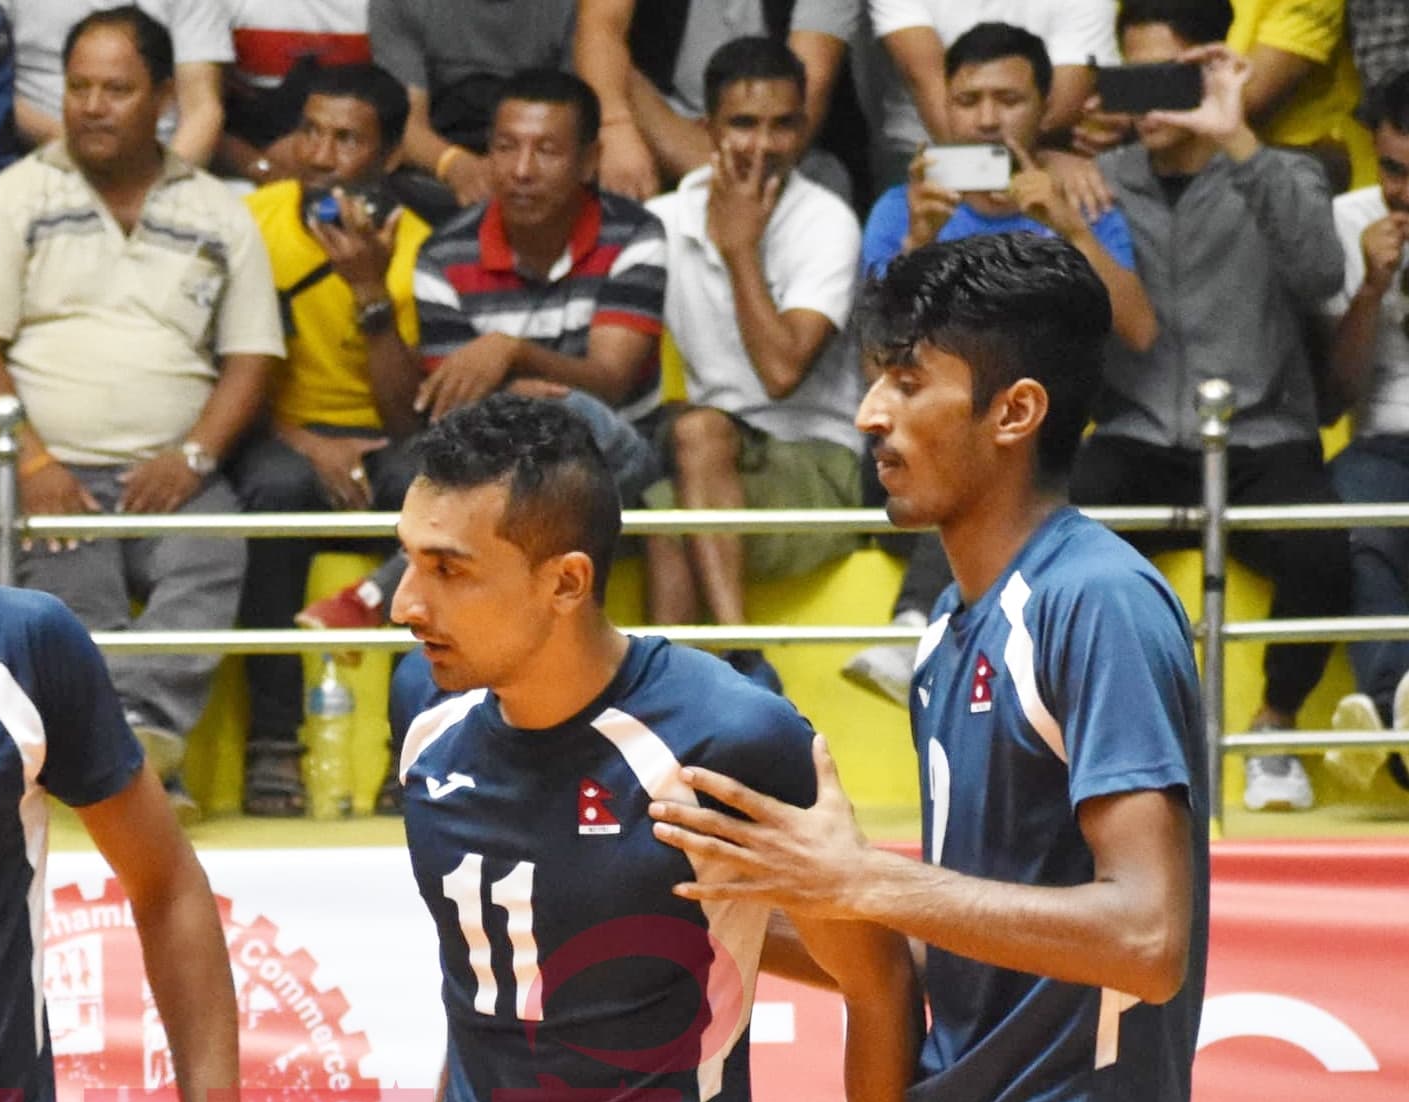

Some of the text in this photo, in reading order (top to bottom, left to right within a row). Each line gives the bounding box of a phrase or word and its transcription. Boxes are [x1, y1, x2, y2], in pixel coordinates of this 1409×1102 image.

[43, 898, 137, 941] ham
[240, 938, 353, 1092] Commerce
[442, 852, 544, 1022] 11
